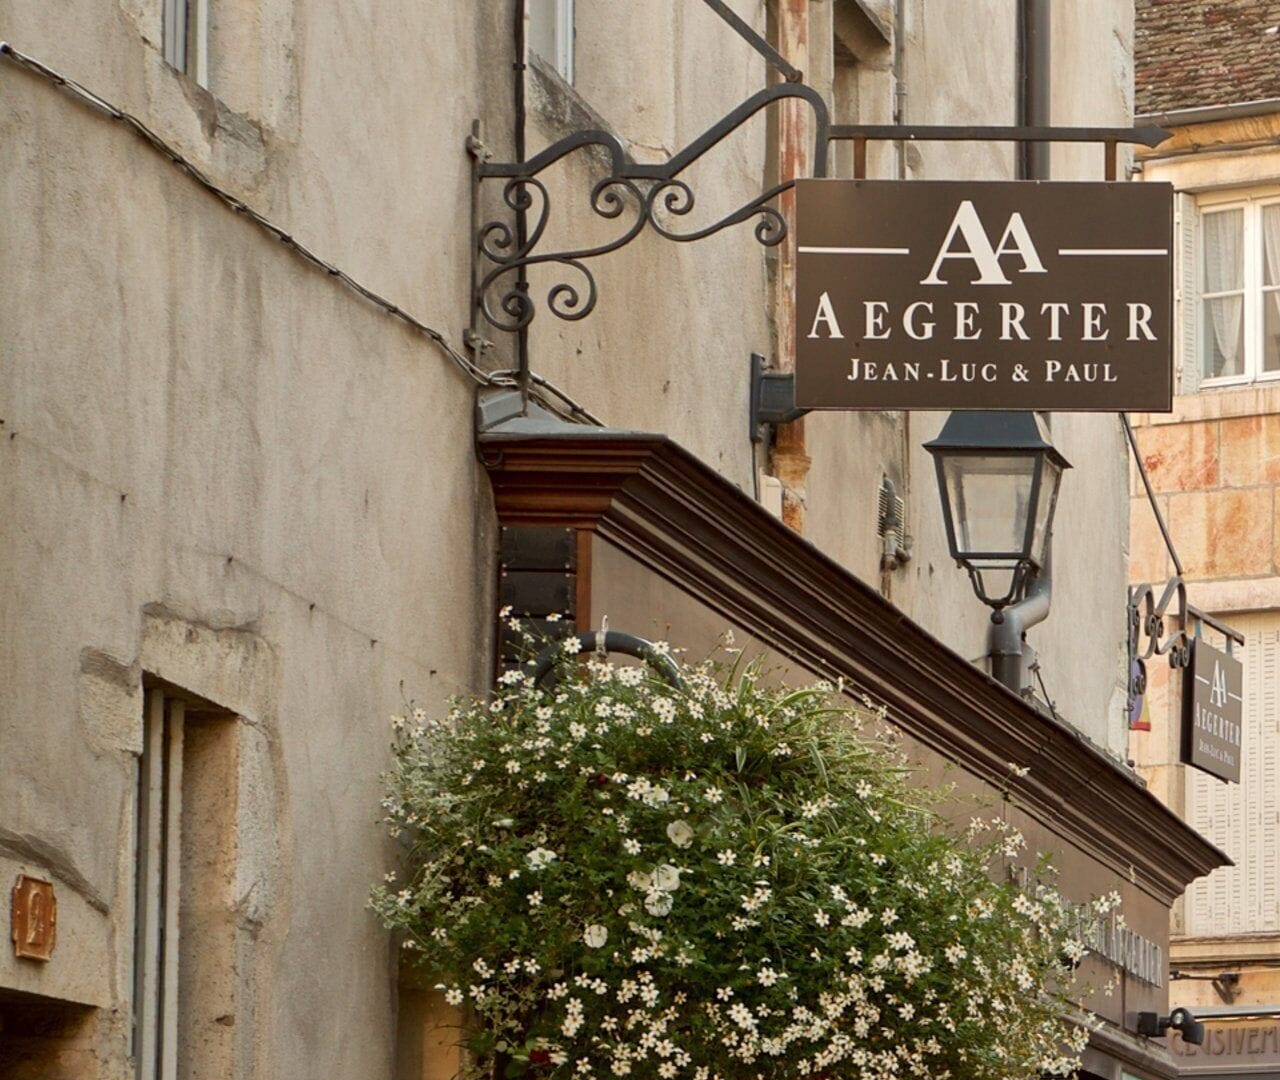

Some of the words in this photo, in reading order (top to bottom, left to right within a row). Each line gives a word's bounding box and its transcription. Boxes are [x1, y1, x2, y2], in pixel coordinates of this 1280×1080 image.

[807, 291, 1158, 342] AEGERTER
[847, 357, 998, 383] JEAN-LUC
[1011, 360, 1029, 383] &
[1045, 358, 1118, 383] PAUL
[1194, 702, 1240, 746] AEGERTER
